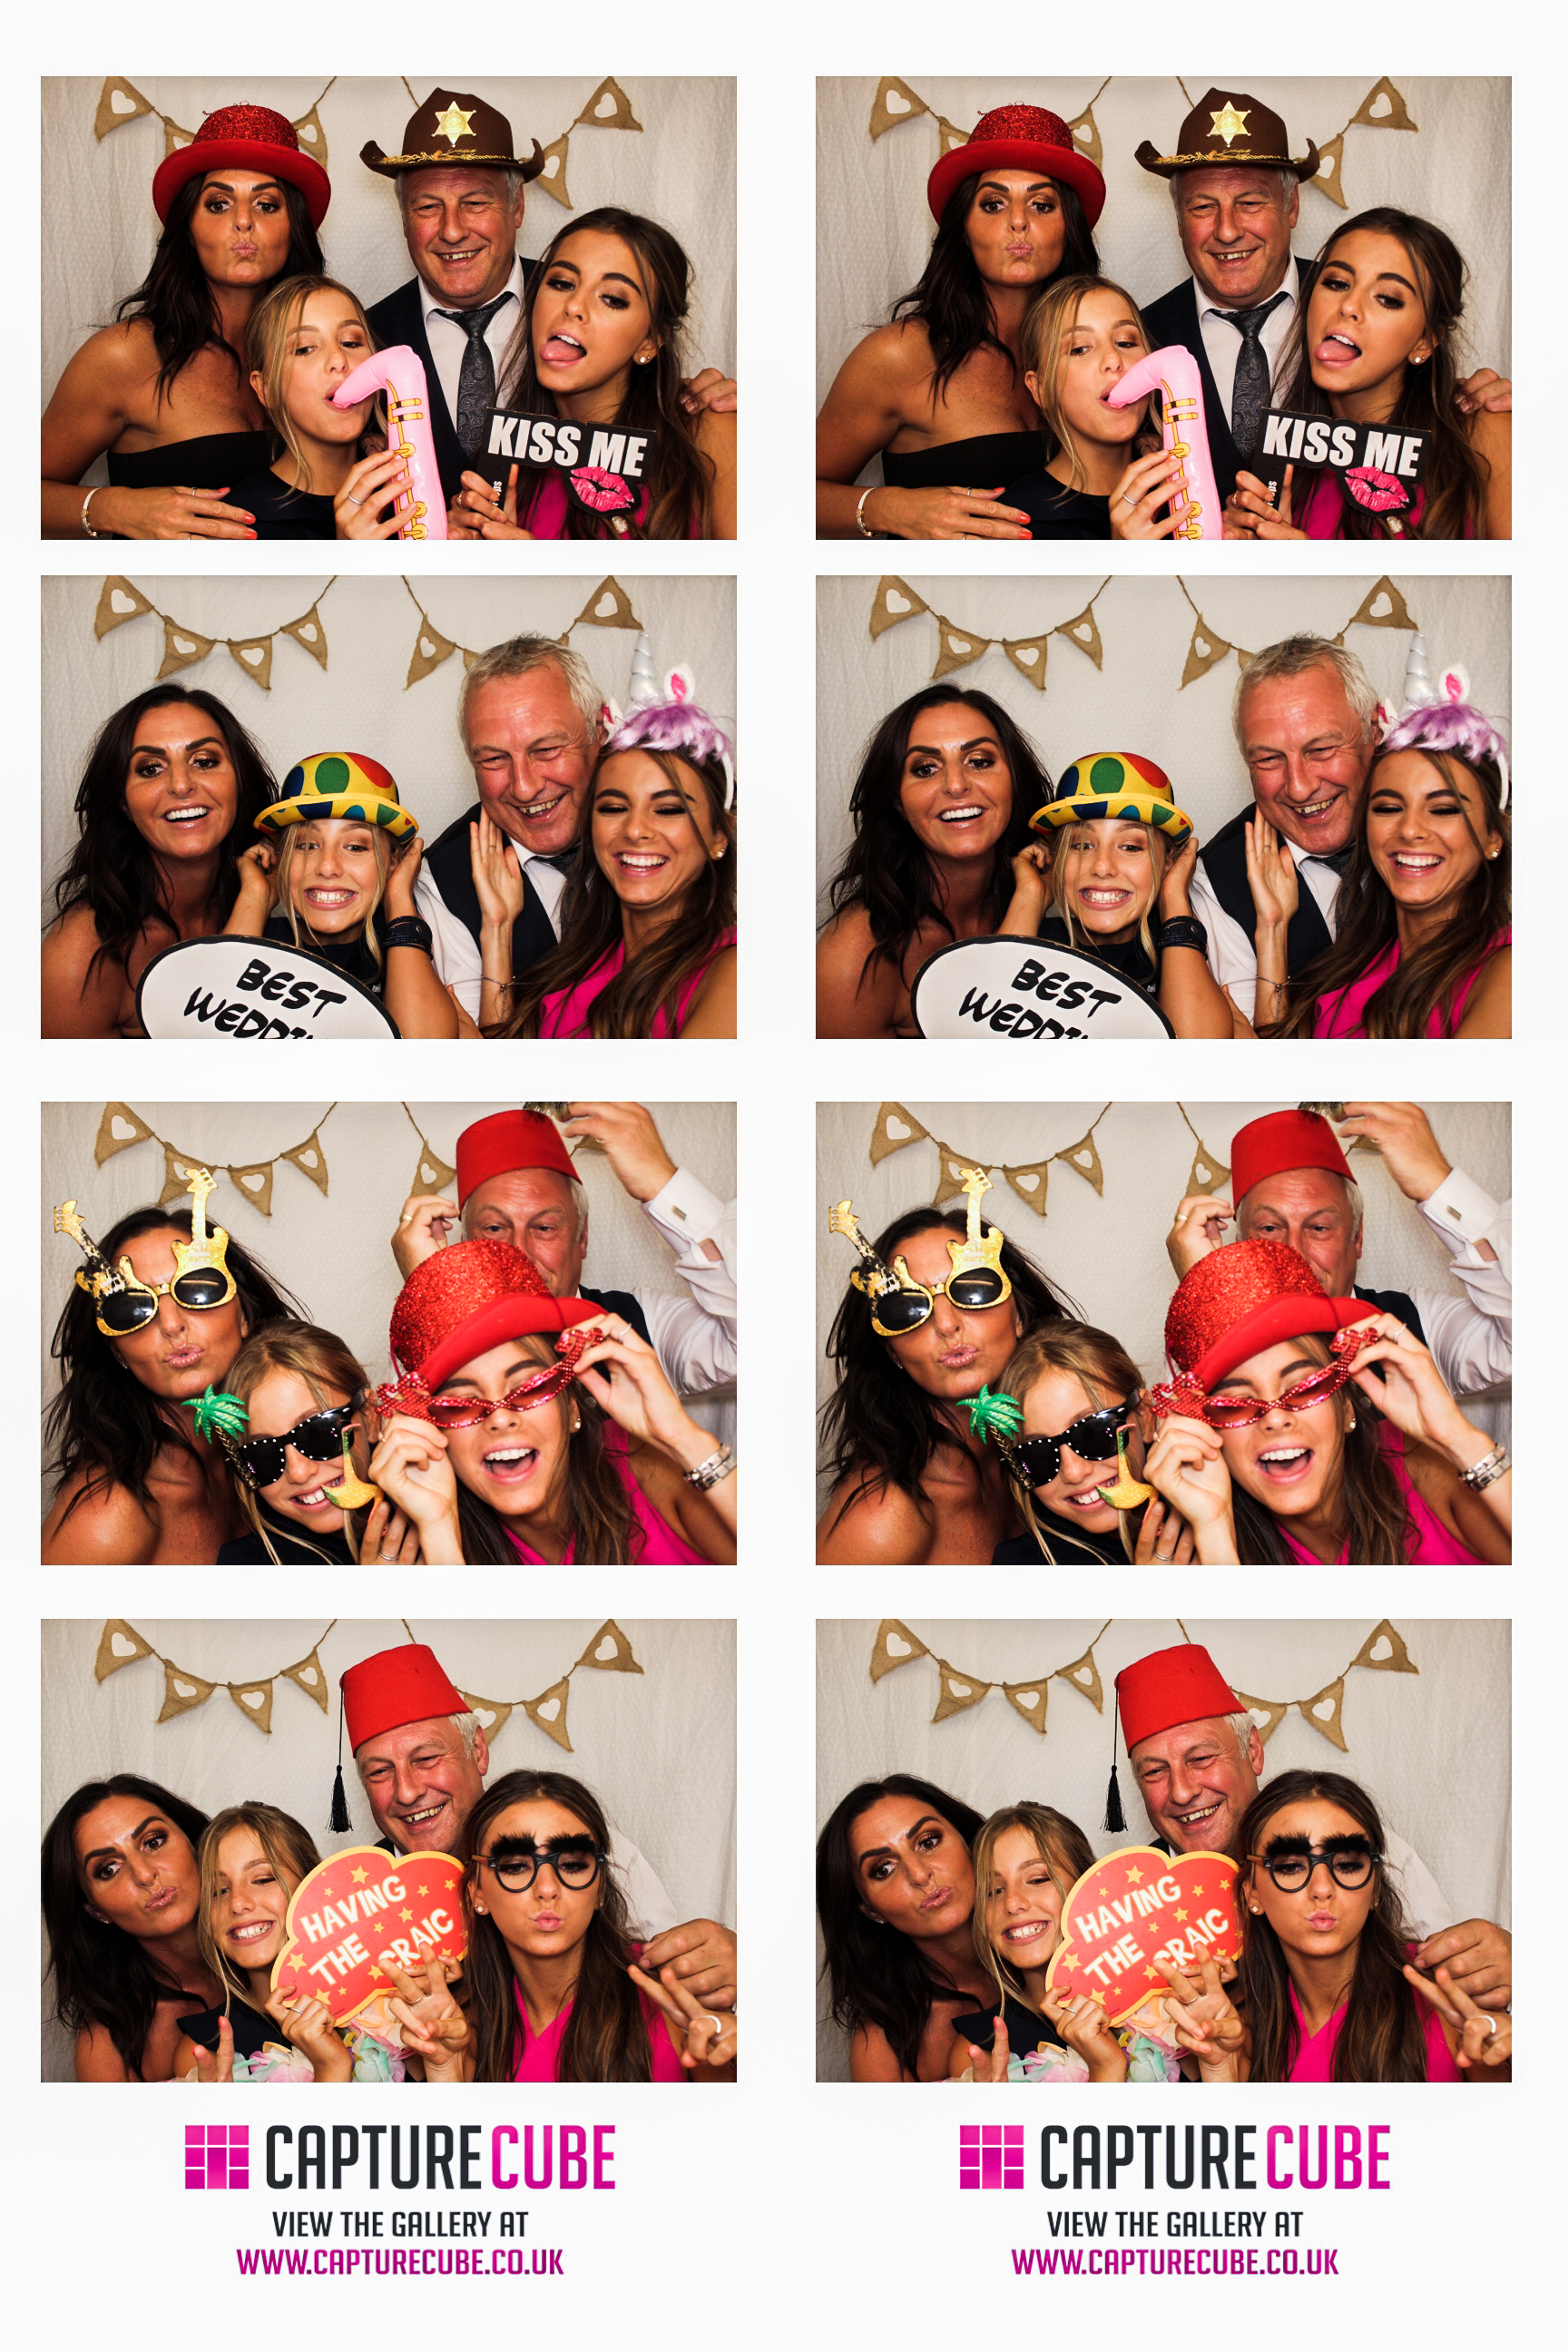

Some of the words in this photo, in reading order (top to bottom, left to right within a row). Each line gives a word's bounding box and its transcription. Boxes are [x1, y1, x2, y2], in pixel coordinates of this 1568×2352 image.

[487, 415, 582, 466] KISS
[588, 430, 648, 477] ME
[1262, 415, 1357, 466] KISS
[1363, 430, 1423, 477] ME
[183, 986, 314, 1039] WEDD
[236, 958, 348, 1018] BEST
[958, 986, 1089, 1039] WEDD
[1011, 958, 1122, 1018] BEST
[299, 1876, 407, 1944] HAVING
[1073, 1876, 1181, 1944] HAVING
[308, 1933, 371, 1985] THE
[1083, 1933, 1146, 1985] THE
